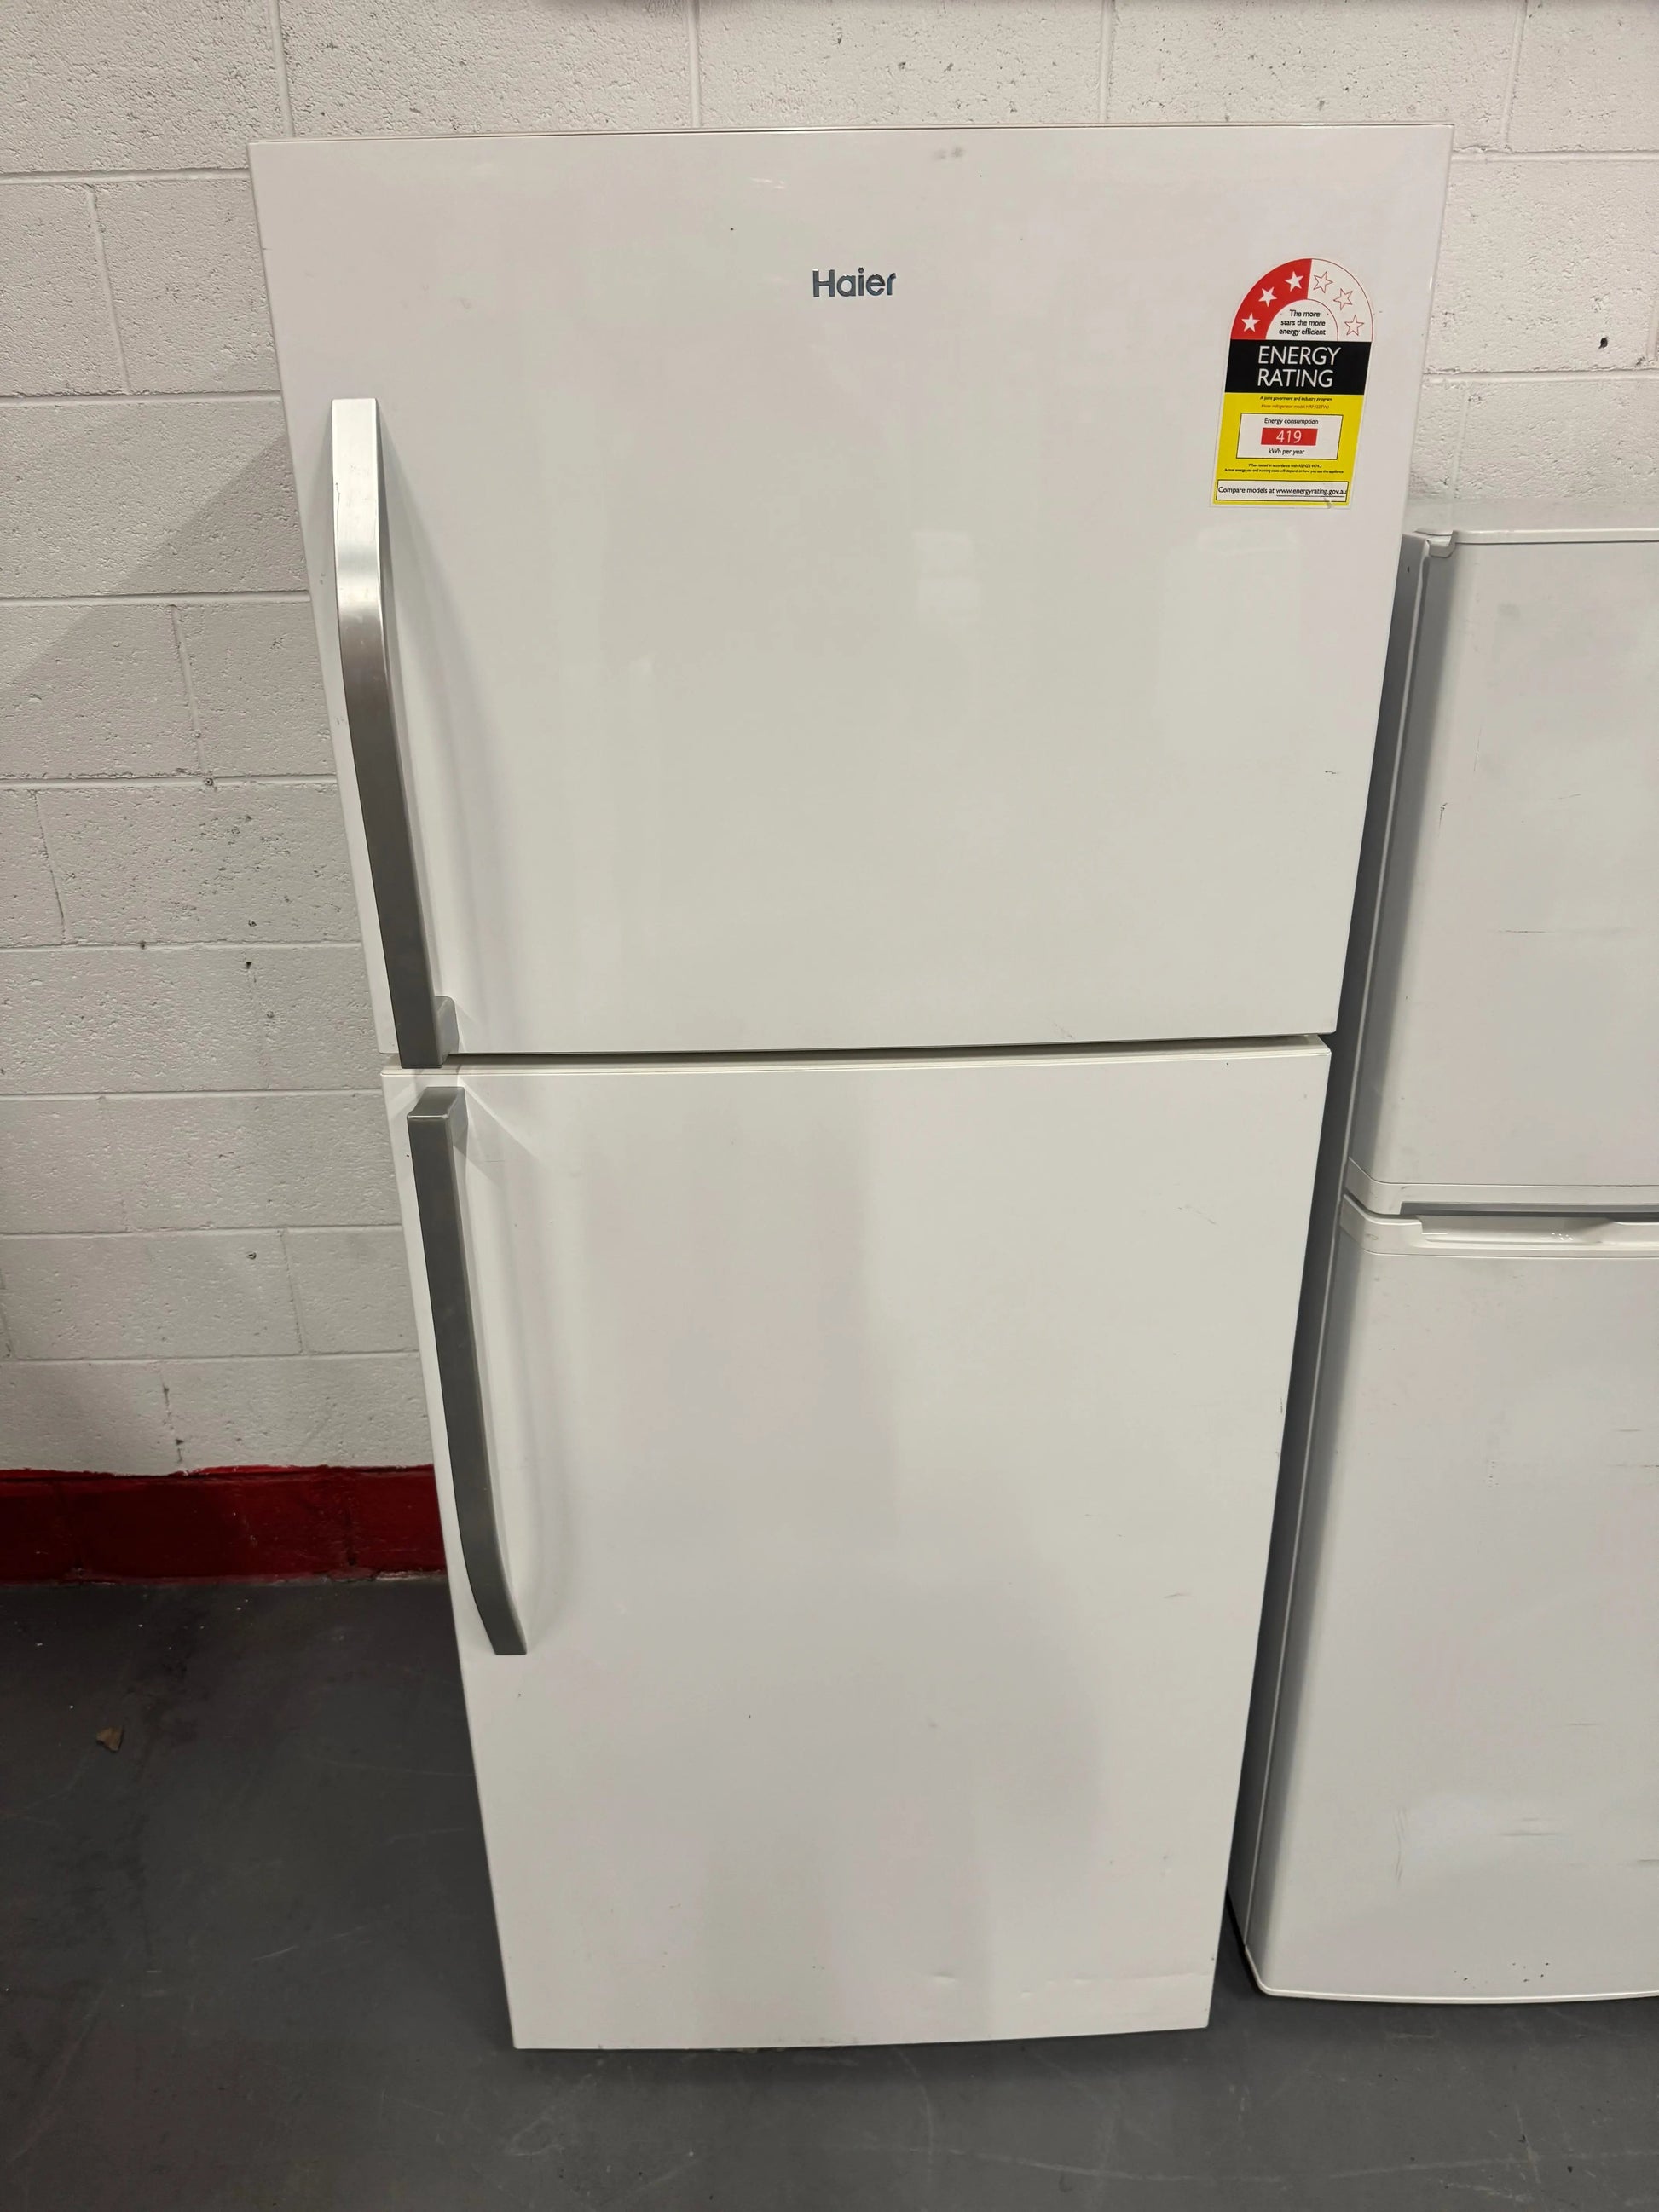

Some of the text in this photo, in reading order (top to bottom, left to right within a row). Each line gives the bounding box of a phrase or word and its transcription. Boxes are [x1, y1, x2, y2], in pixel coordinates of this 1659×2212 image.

[812, 267, 896, 297] Haier
[1258, 345, 1341, 366] ENERGY
[1257, 368, 1333, 388] RATING
[1275, 430, 1302, 443] 419
